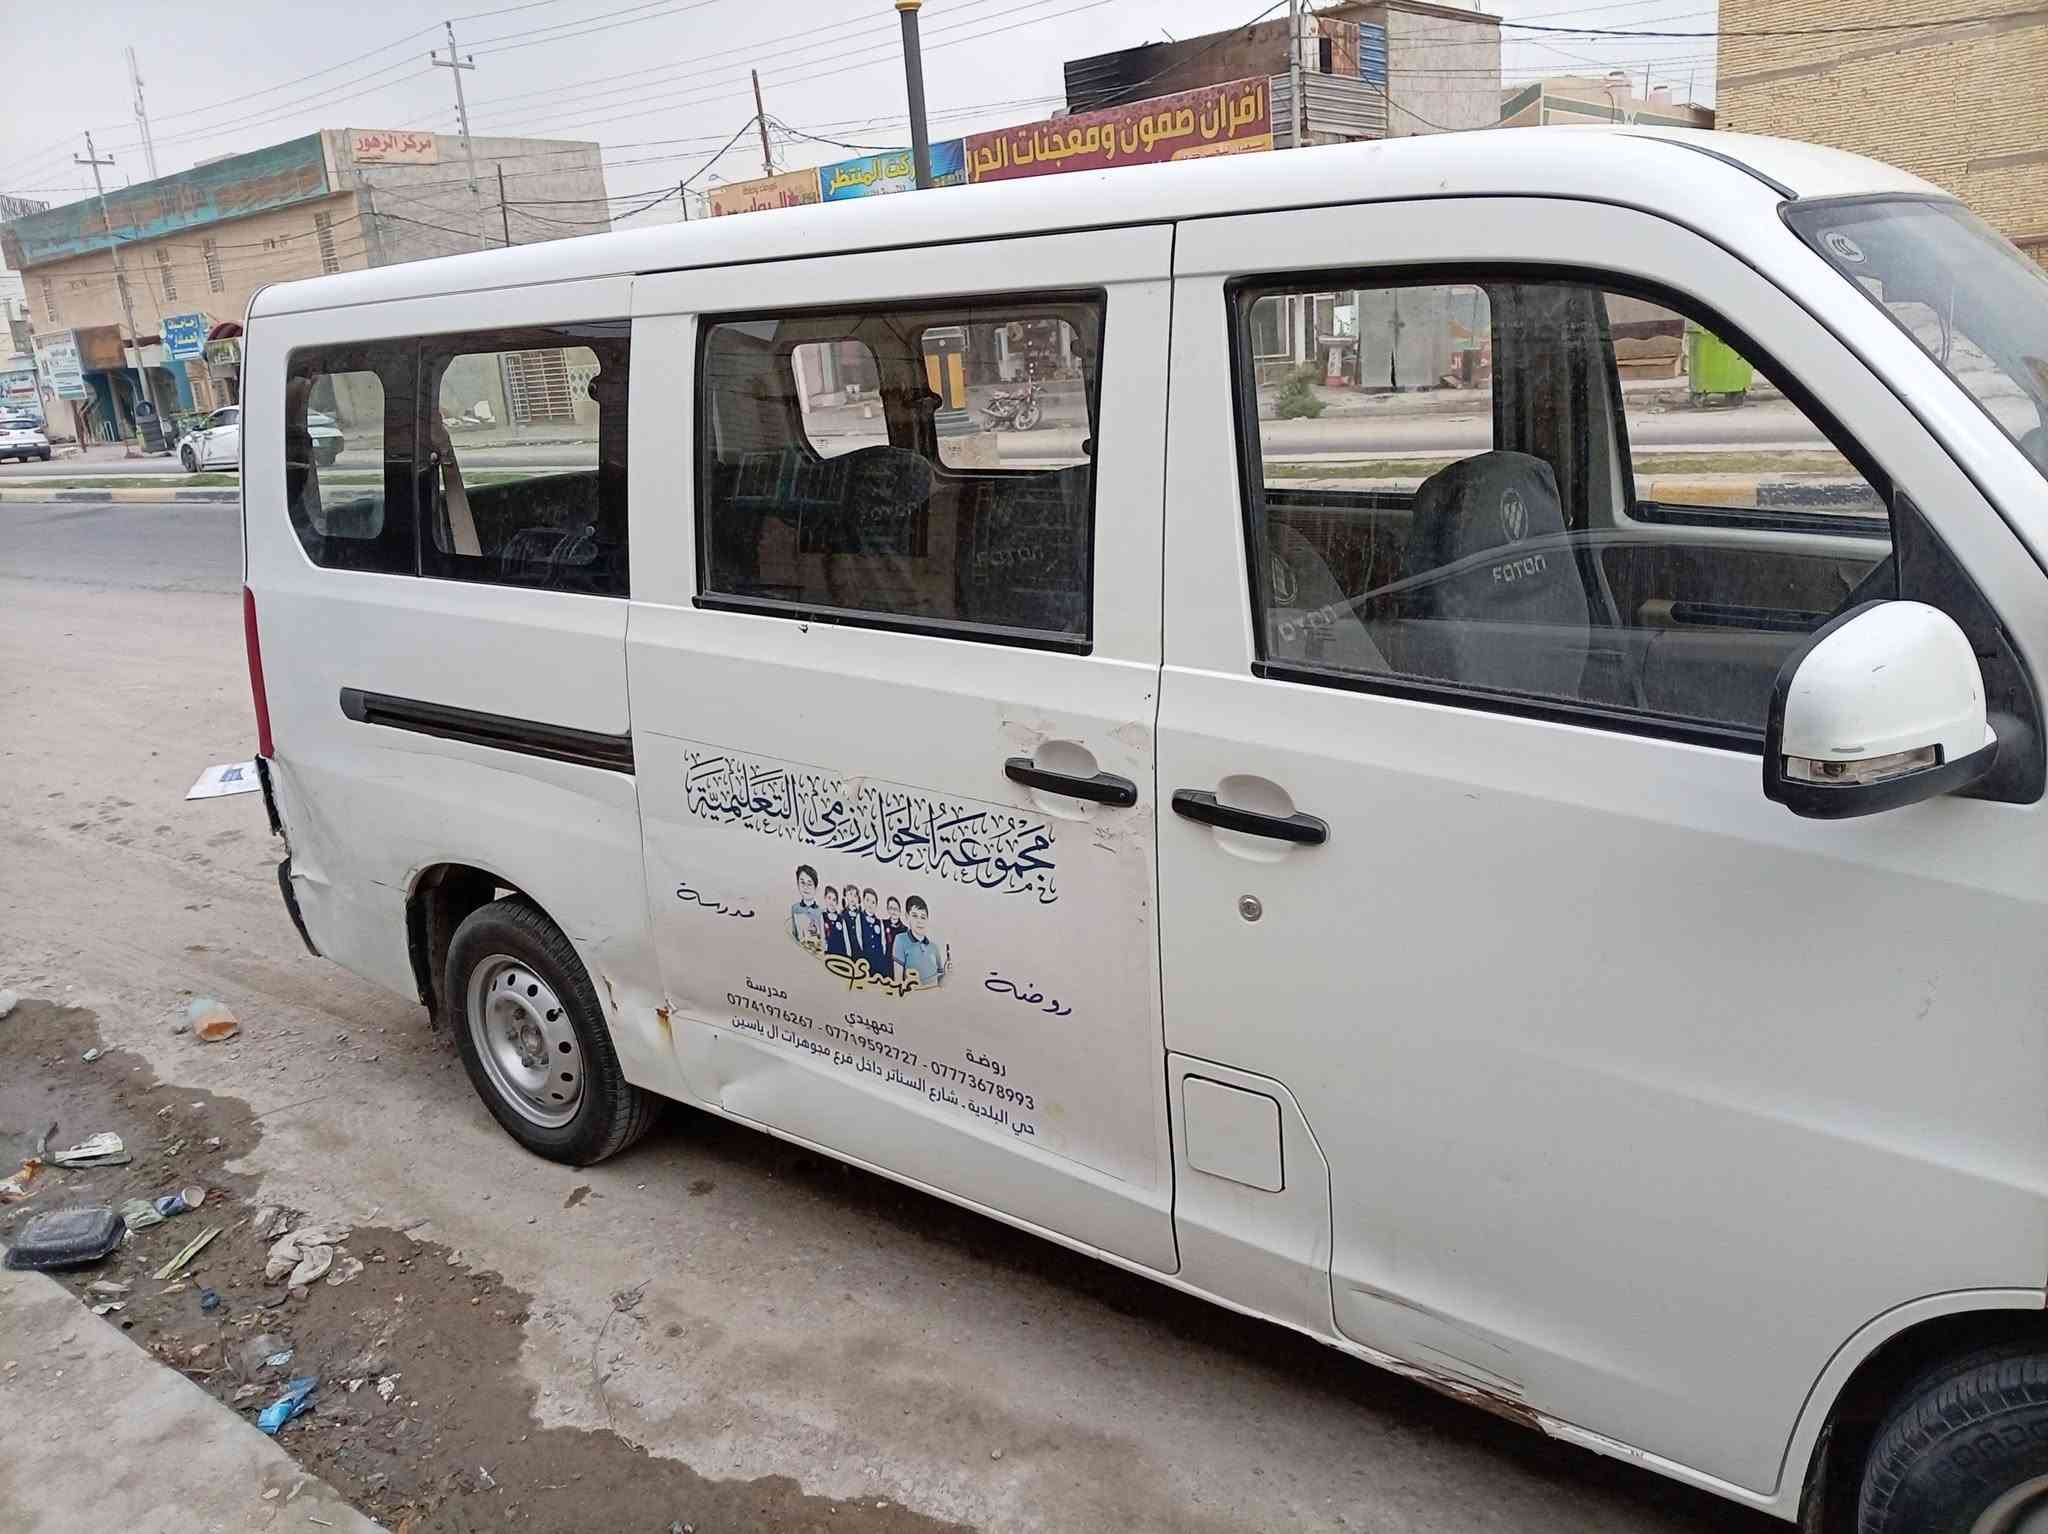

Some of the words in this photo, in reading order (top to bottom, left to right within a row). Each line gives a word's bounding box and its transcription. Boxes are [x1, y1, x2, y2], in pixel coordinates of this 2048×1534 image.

[1199, 84, 1264, 139] افران
[399, 133, 432, 153] مركز
[1120, 106, 1195, 153] صمون
[1012, 122, 1116, 168] ومعجنات
[828, 158, 882, 197] المنتظر
[676, 882, 756, 919] مدرسة
[744, 976, 788, 1001] مدرسة
[984, 970, 1073, 1017] روضة
[731, 1014, 765, 1037] ياسين
[844, 1012, 895, 1036] تمهيدي
[726, 992, 814, 1030] 07741976267
[824, 1023, 919, 1067] 07719592727
[930, 1060, 1035, 1111] 07773678993
[780, 1030, 832, 1057] مجوهرات
[855, 1055, 883, 1076] داخل
[965, 1047, 1007, 1077] روضة
[928, 1087, 959, 1103] شارع
[967, 1098, 1009, 1126] البلدية
[1011, 1121, 1036, 1137] حي
